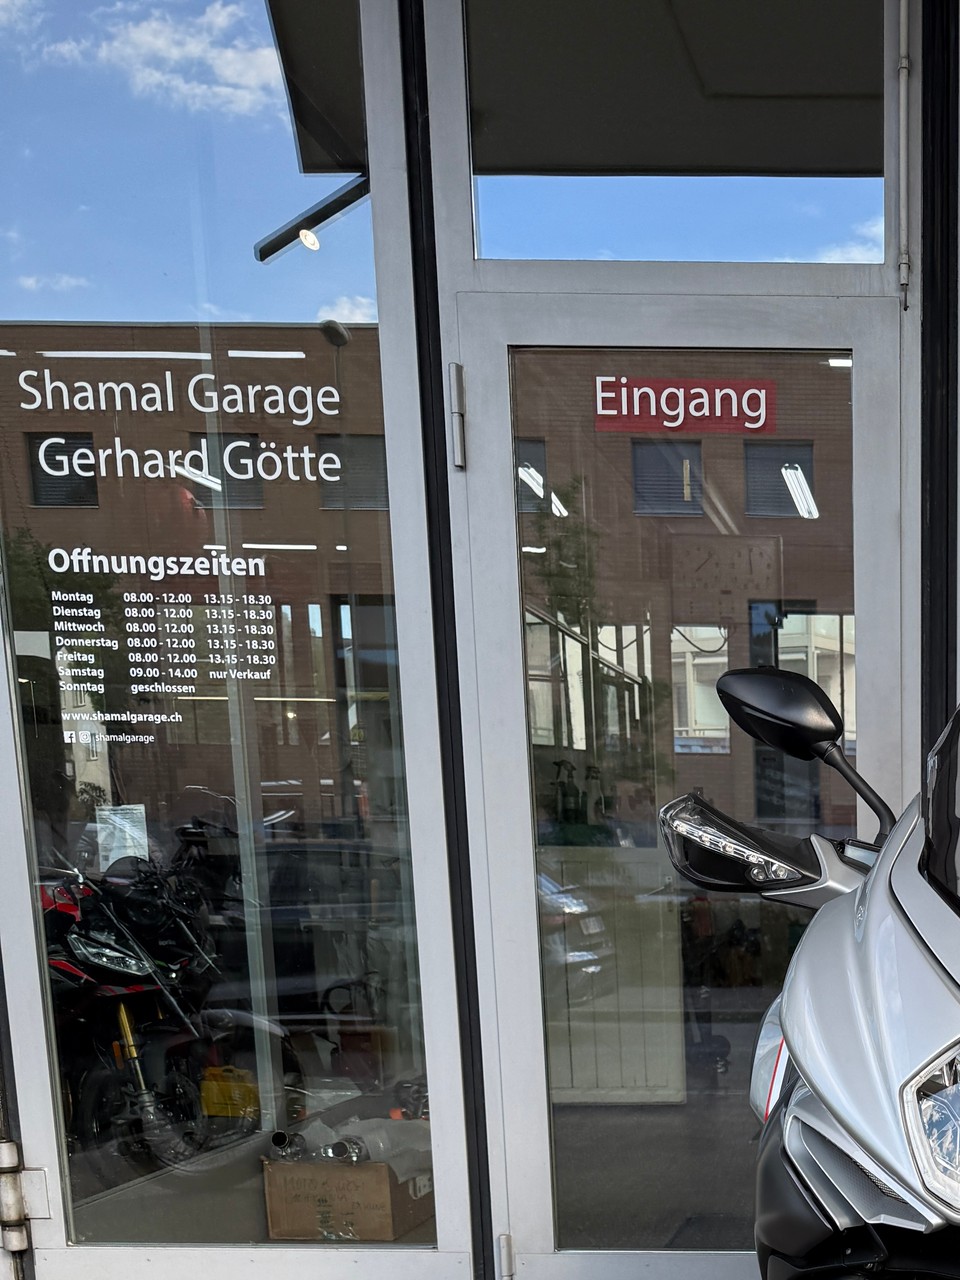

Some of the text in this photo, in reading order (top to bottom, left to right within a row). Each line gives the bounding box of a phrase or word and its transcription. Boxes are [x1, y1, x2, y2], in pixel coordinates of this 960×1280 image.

[19, 369, 340, 425] Shamal Garage
[596, 376, 767, 429] Eingang
[38, 437, 341, 481] Gerhard Götte
[52, 591, 93, 603] Montag
[123, 593, 153, 602] 08.00
[162, 594, 192, 603] 12.00
[204, 595, 233, 604] 13.15
[242, 595, 271, 604] 18.30
[53, 606, 101, 619] Dienstag
[125, 608, 154, 617] 08.00
[164, 609, 193, 618] 12.00
[205, 610, 234, 619] 13.15
[243, 610, 272, 619] 18.30
[54, 621, 105, 632] Mittwoch
[126, 623, 156, 632] 08.00
[165, 624, 194, 633] 12.00
[206, 625, 235, 634] 13.15
[244, 625, 273, 635] 18.30
[55, 637, 118, 649] Donnerstag
[127, 638, 157, 647] 08.00
[166, 639, 195, 648] 12.00
[207, 640, 236, 649] 13.15
[245, 640, 274, 650] 18.30
[57, 652, 94, 664] Freitag
[128, 653, 158, 663] 08.00
[167, 654, 197, 663] 12.00
[208, 655, 237, 664] 13.15
[246, 655, 275, 665] 18.30
[58, 667, 104, 678] Samstag
[130, 668, 159, 678] 09.00
[169, 669, 198, 678] 14.00
[209, 670, 227, 678] nur
[230, 669, 271, 679] Verkauf
[59, 682, 195, 694] Sonntag geschlossen
[61, 711, 182, 723] www.shamalgarage.ch
[95, 733, 155, 744] shamalgarage
